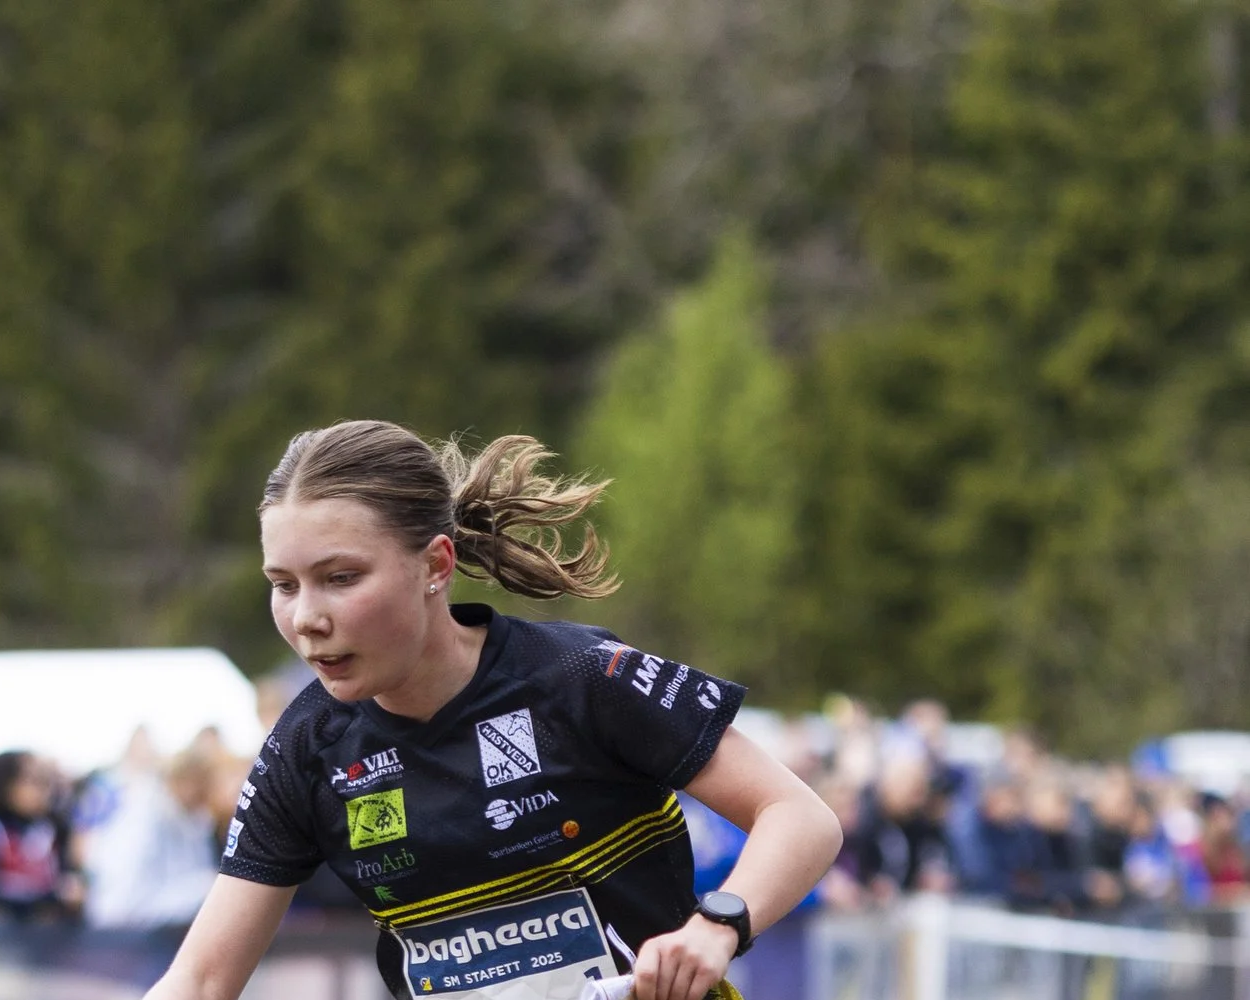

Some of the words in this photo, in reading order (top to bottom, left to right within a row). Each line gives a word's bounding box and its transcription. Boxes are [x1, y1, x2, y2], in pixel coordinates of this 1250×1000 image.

[362, 747, 400, 772] VILT
[486, 760, 513, 780] OK
[510, 789, 560, 816] VIDA
[354, 847, 416, 879] ProArb
[405, 906, 591, 965] bagheera
[443, 975, 461, 988] SM
[465, 961, 521, 985] STAFETT
[530, 952, 563, 969] 2025
